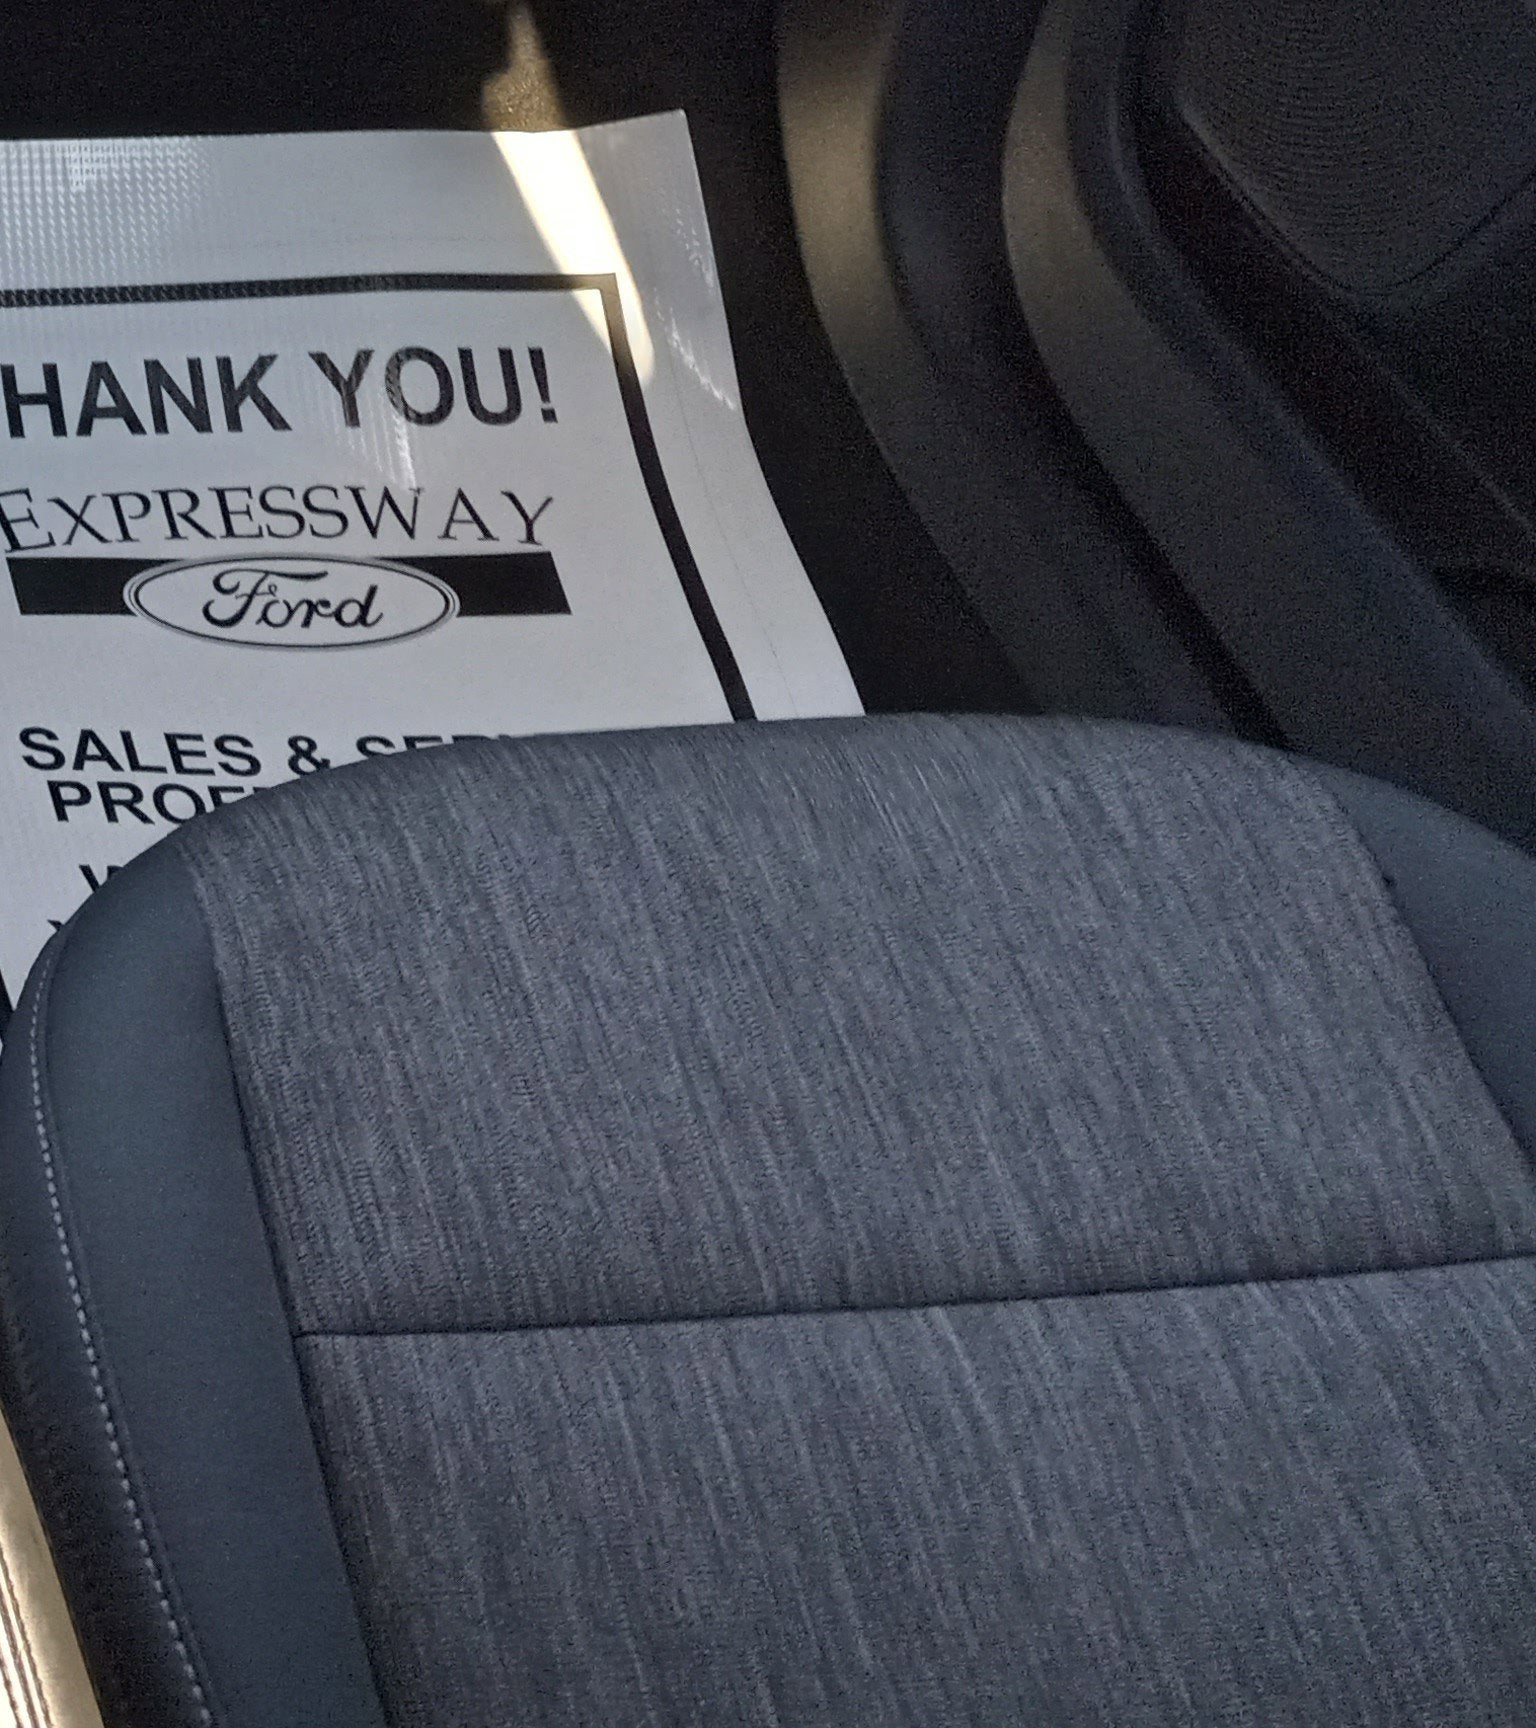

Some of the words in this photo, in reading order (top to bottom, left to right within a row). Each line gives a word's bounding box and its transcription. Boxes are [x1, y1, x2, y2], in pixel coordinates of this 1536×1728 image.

[309, 345, 560, 429] YOU!
[201, 567, 385, 631] Ford
[18, 726, 263, 778] SALES
[287, 735, 332, 775] &
